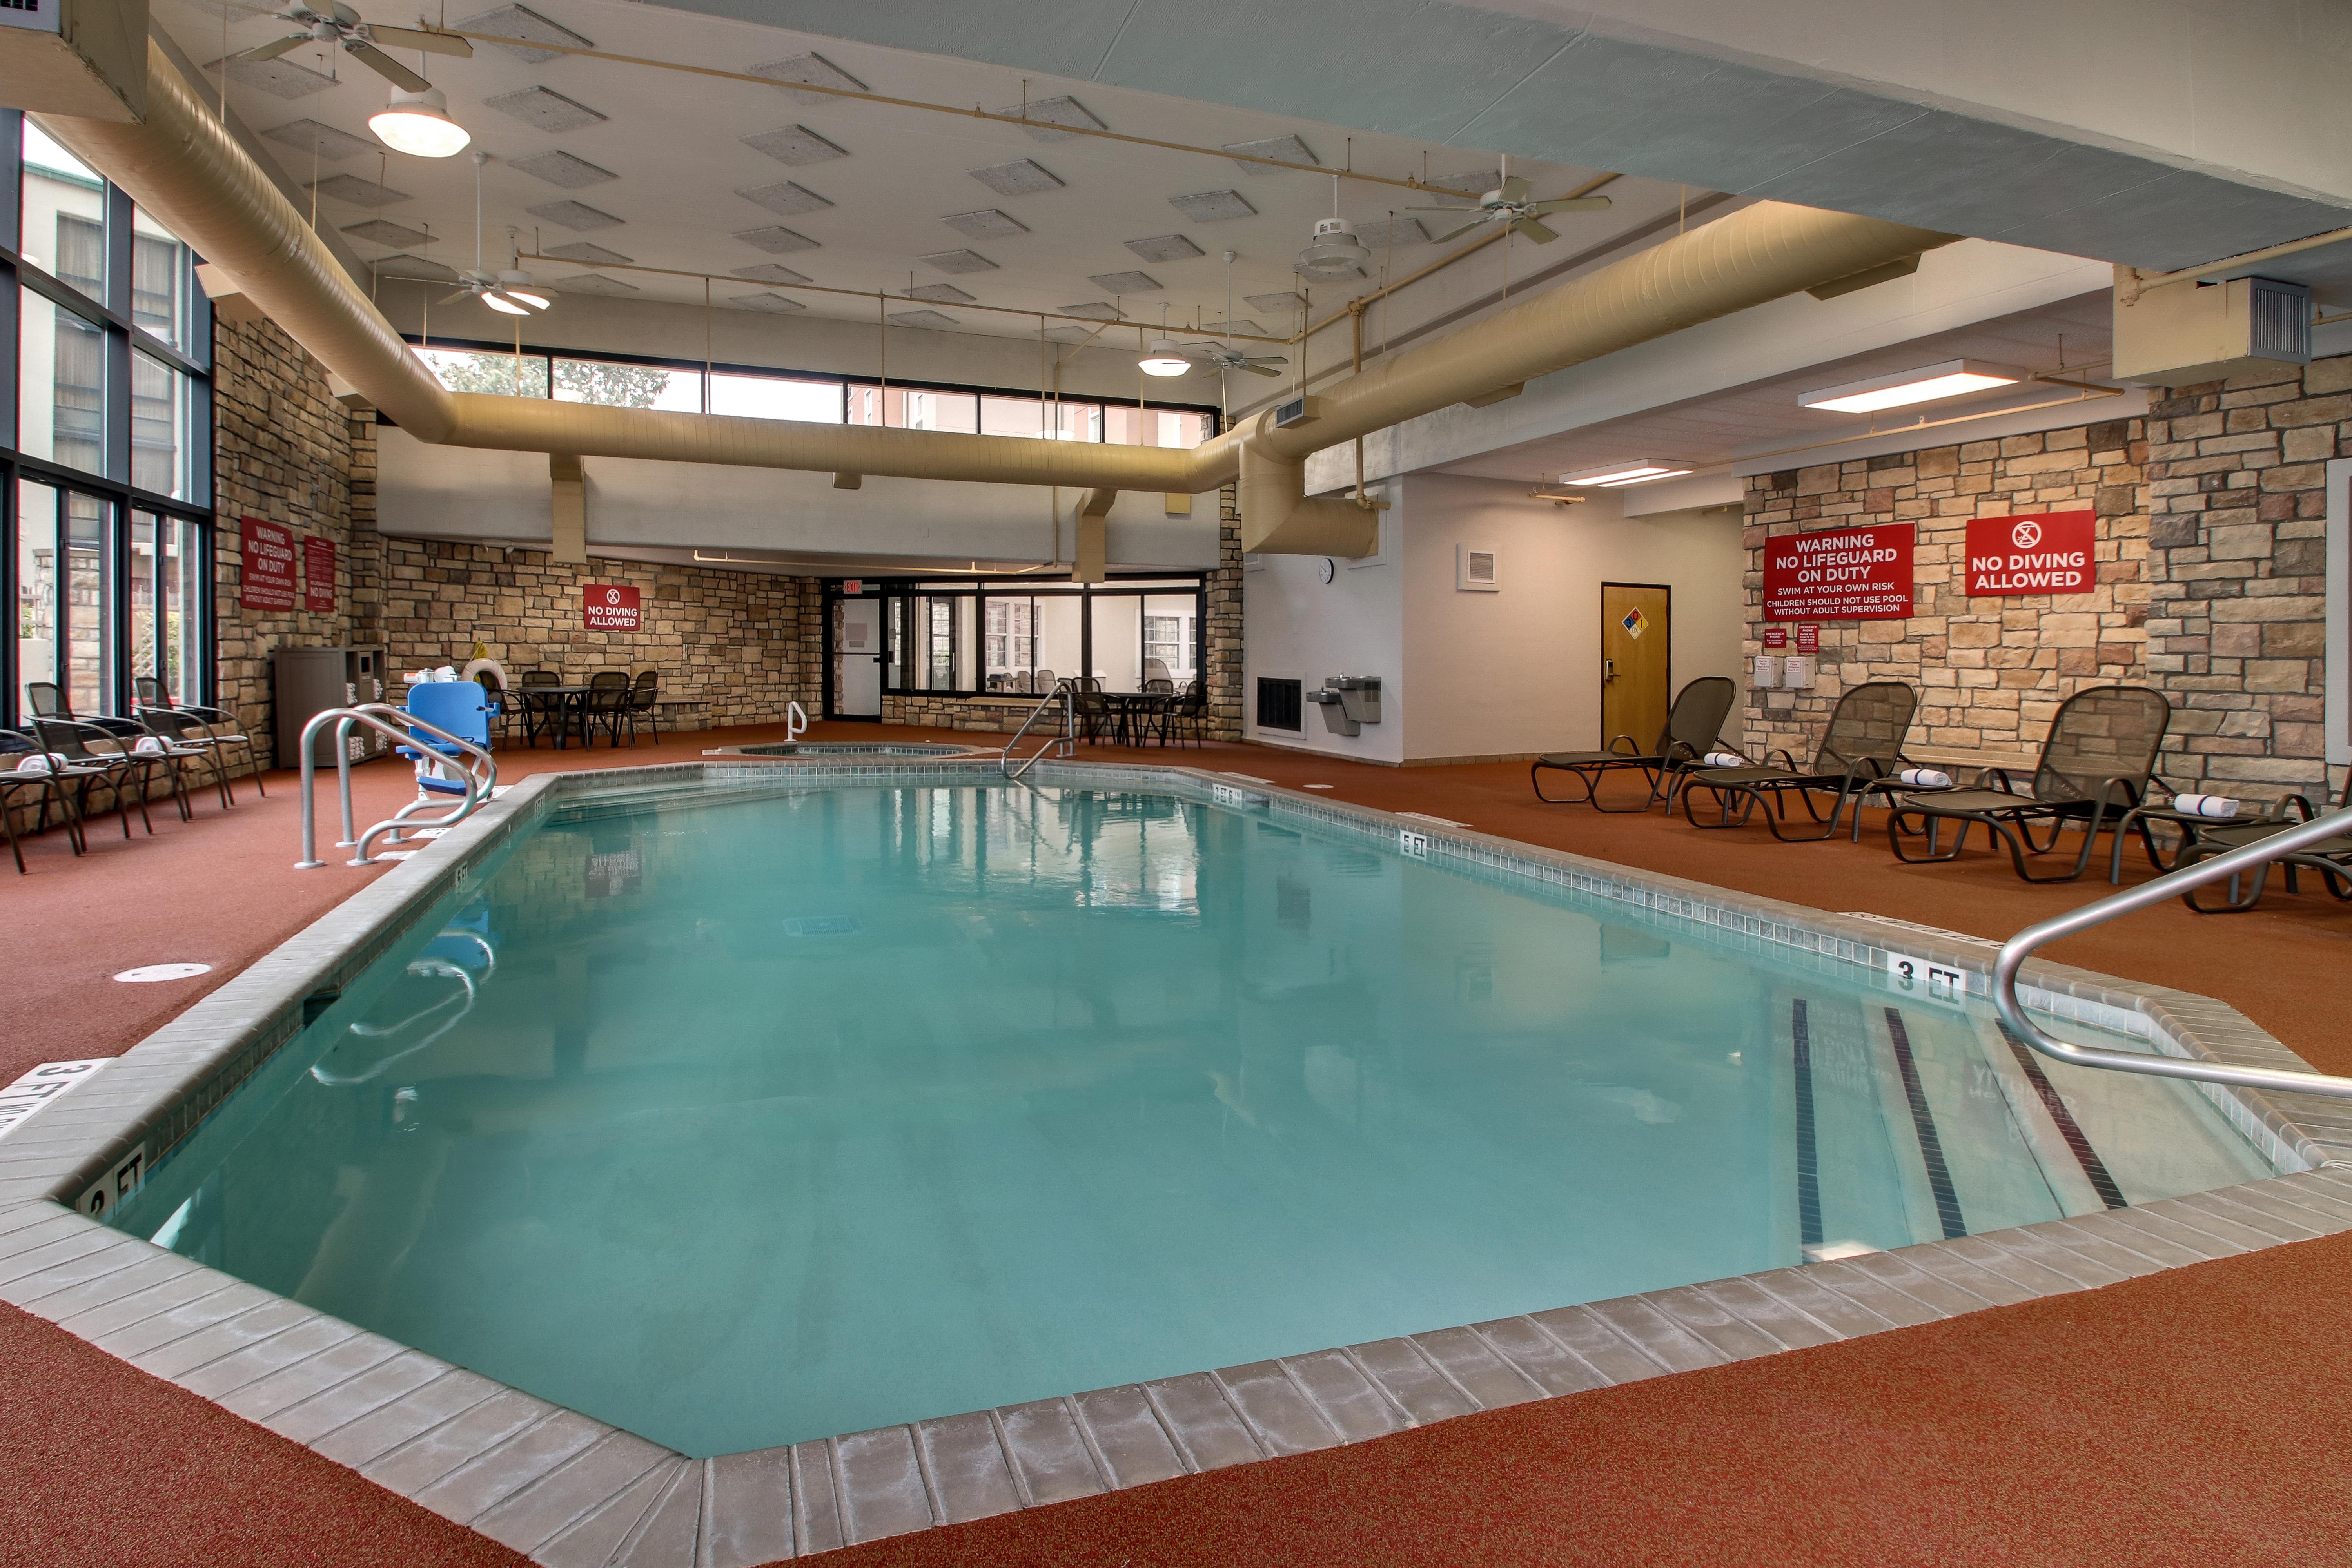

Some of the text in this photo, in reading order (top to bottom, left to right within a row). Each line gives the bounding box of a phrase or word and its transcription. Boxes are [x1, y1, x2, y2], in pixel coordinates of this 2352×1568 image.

[256, 526, 285, 545] WARNING
[248, 539, 259, 554] NO
[260, 543, 292, 561] LIFEGUARD
[1796, 534, 1874, 552] WARNING
[1776, 548, 1897, 569] NO LIFEGUARD
[1972, 552, 2085, 572] NO DIVING
[258, 558, 285, 574] ON DUTY
[249, 573, 260, 581] SWIM
[1798, 566, 1871, 583] ON DUTY
[1975, 571, 2082, 589] ALLOWED
[310, 587, 318, 597] NO
[847, 582, 858, 592] EXIT
[1778, 587, 1800, 595] SWIM
[1817, 584, 1842, 593] YOUR
[1845, 583, 1869, 592] OWN
[1872, 582, 1894, 590] RISK
[1767, 599, 1805, 607] CHILDREN
[1807, 597, 1840, 606] SHOULD
[1841, 604, 1900, 613] SUPERVISION
[588, 606, 637, 617] NO DIVING
[1633, 611, 1638, 620] 0
[590, 616, 636, 626] ALLOWED
[1627, 619, 1642, 628] 3 1
[1898, 961, 1959, 987] 3 FT
[0, 1065, 93, 1099] 3 FT
